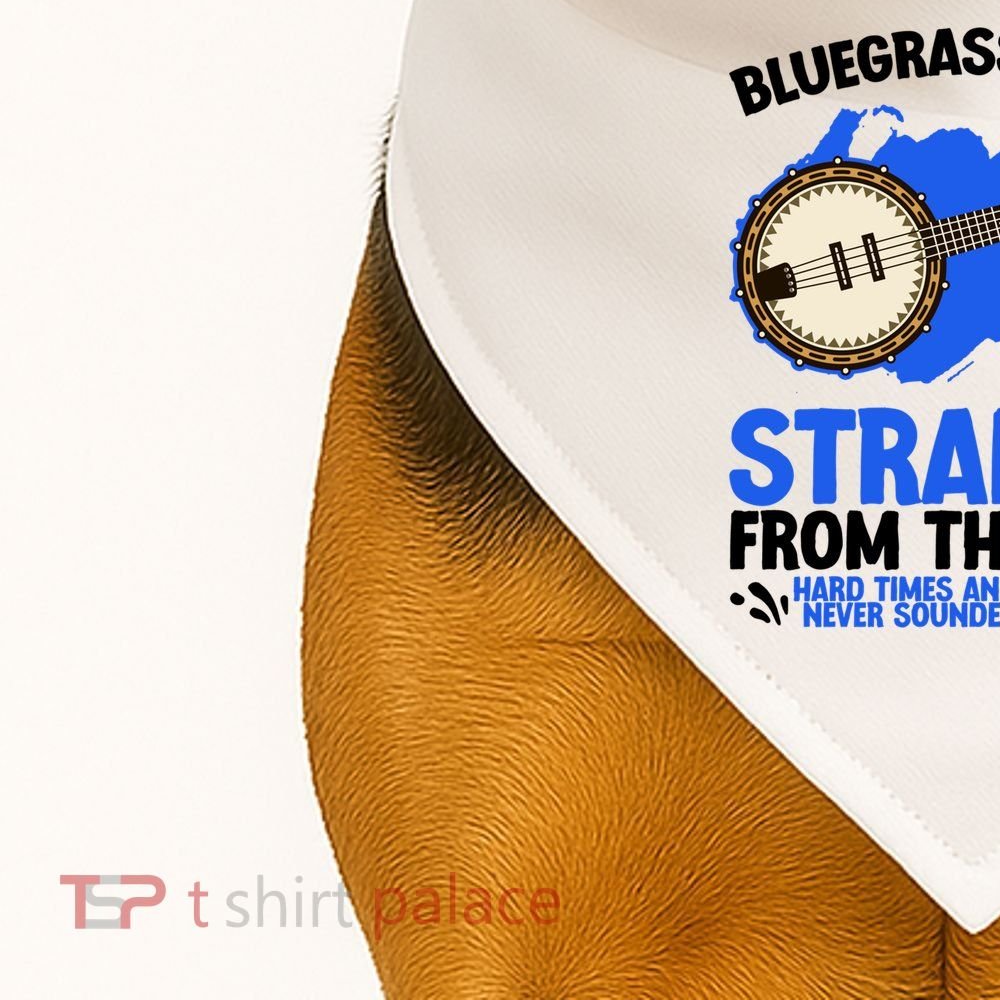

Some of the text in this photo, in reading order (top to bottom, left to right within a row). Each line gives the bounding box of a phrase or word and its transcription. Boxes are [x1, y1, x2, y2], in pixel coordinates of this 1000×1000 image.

[730, 510, 900, 571] FROM
[793, 576, 865, 602] HARD
[873, 576, 953, 602] TIMES
[803, 602, 885, 628] NEVER
